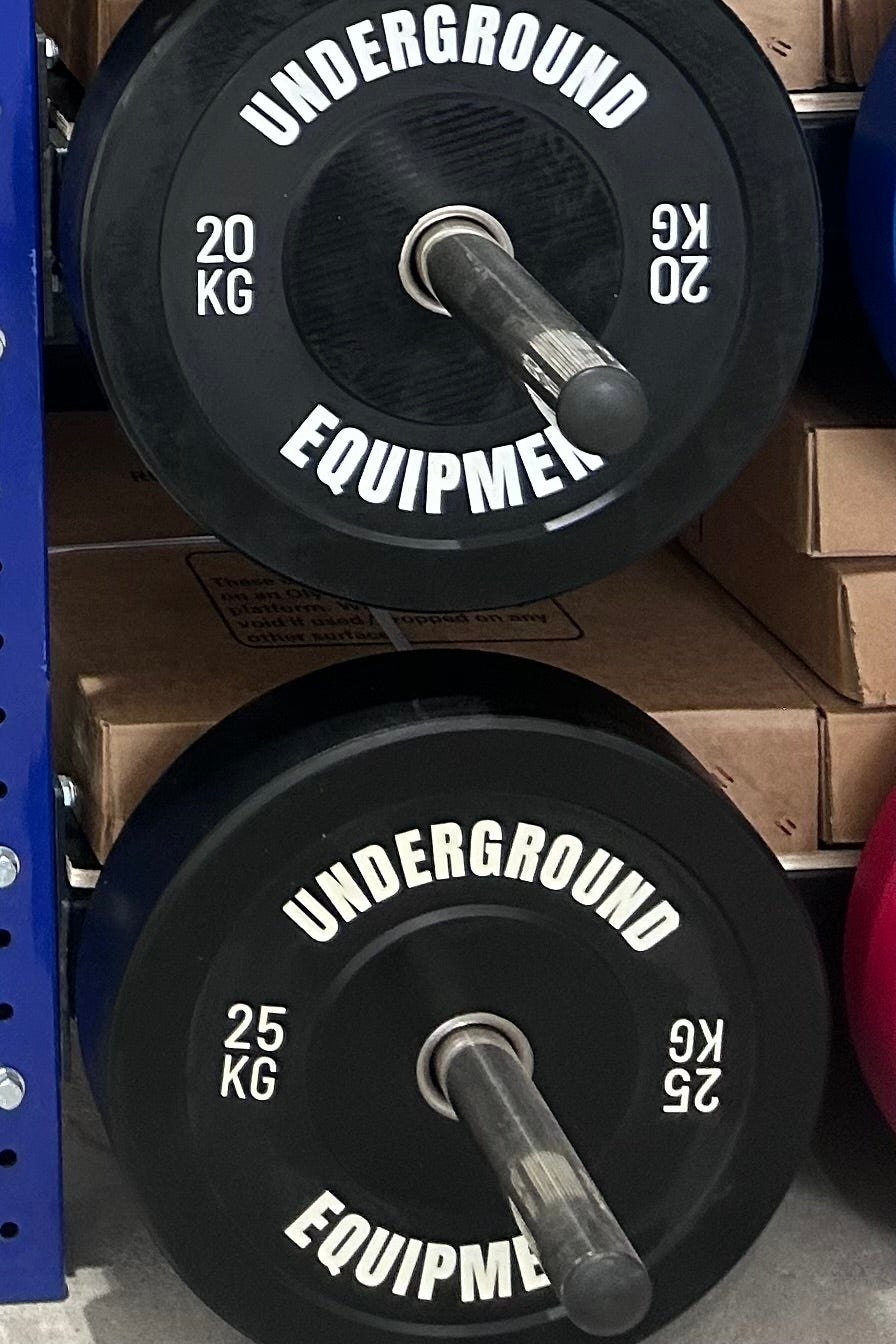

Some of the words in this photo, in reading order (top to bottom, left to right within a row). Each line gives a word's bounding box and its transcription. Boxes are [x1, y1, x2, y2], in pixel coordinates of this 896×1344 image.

[239, 3, 648, 146] UNDERGROUND
[196, 214, 254, 264] 20
[651, 202, 710, 251] KG
[196, 267, 254, 316] KG
[650, 255, 709, 305] 20
[280, 403, 606, 515] EQUIPMEN
[282, 819, 680, 952] UNDERGROUND
[224, 1003, 287, 1052] 25
[668, 1018, 725, 1064] KG
[220, 1054, 277, 1101] KG
[662, 1067, 722, 1113] 25
[284, 1189, 551, 1303] EQUIPME
